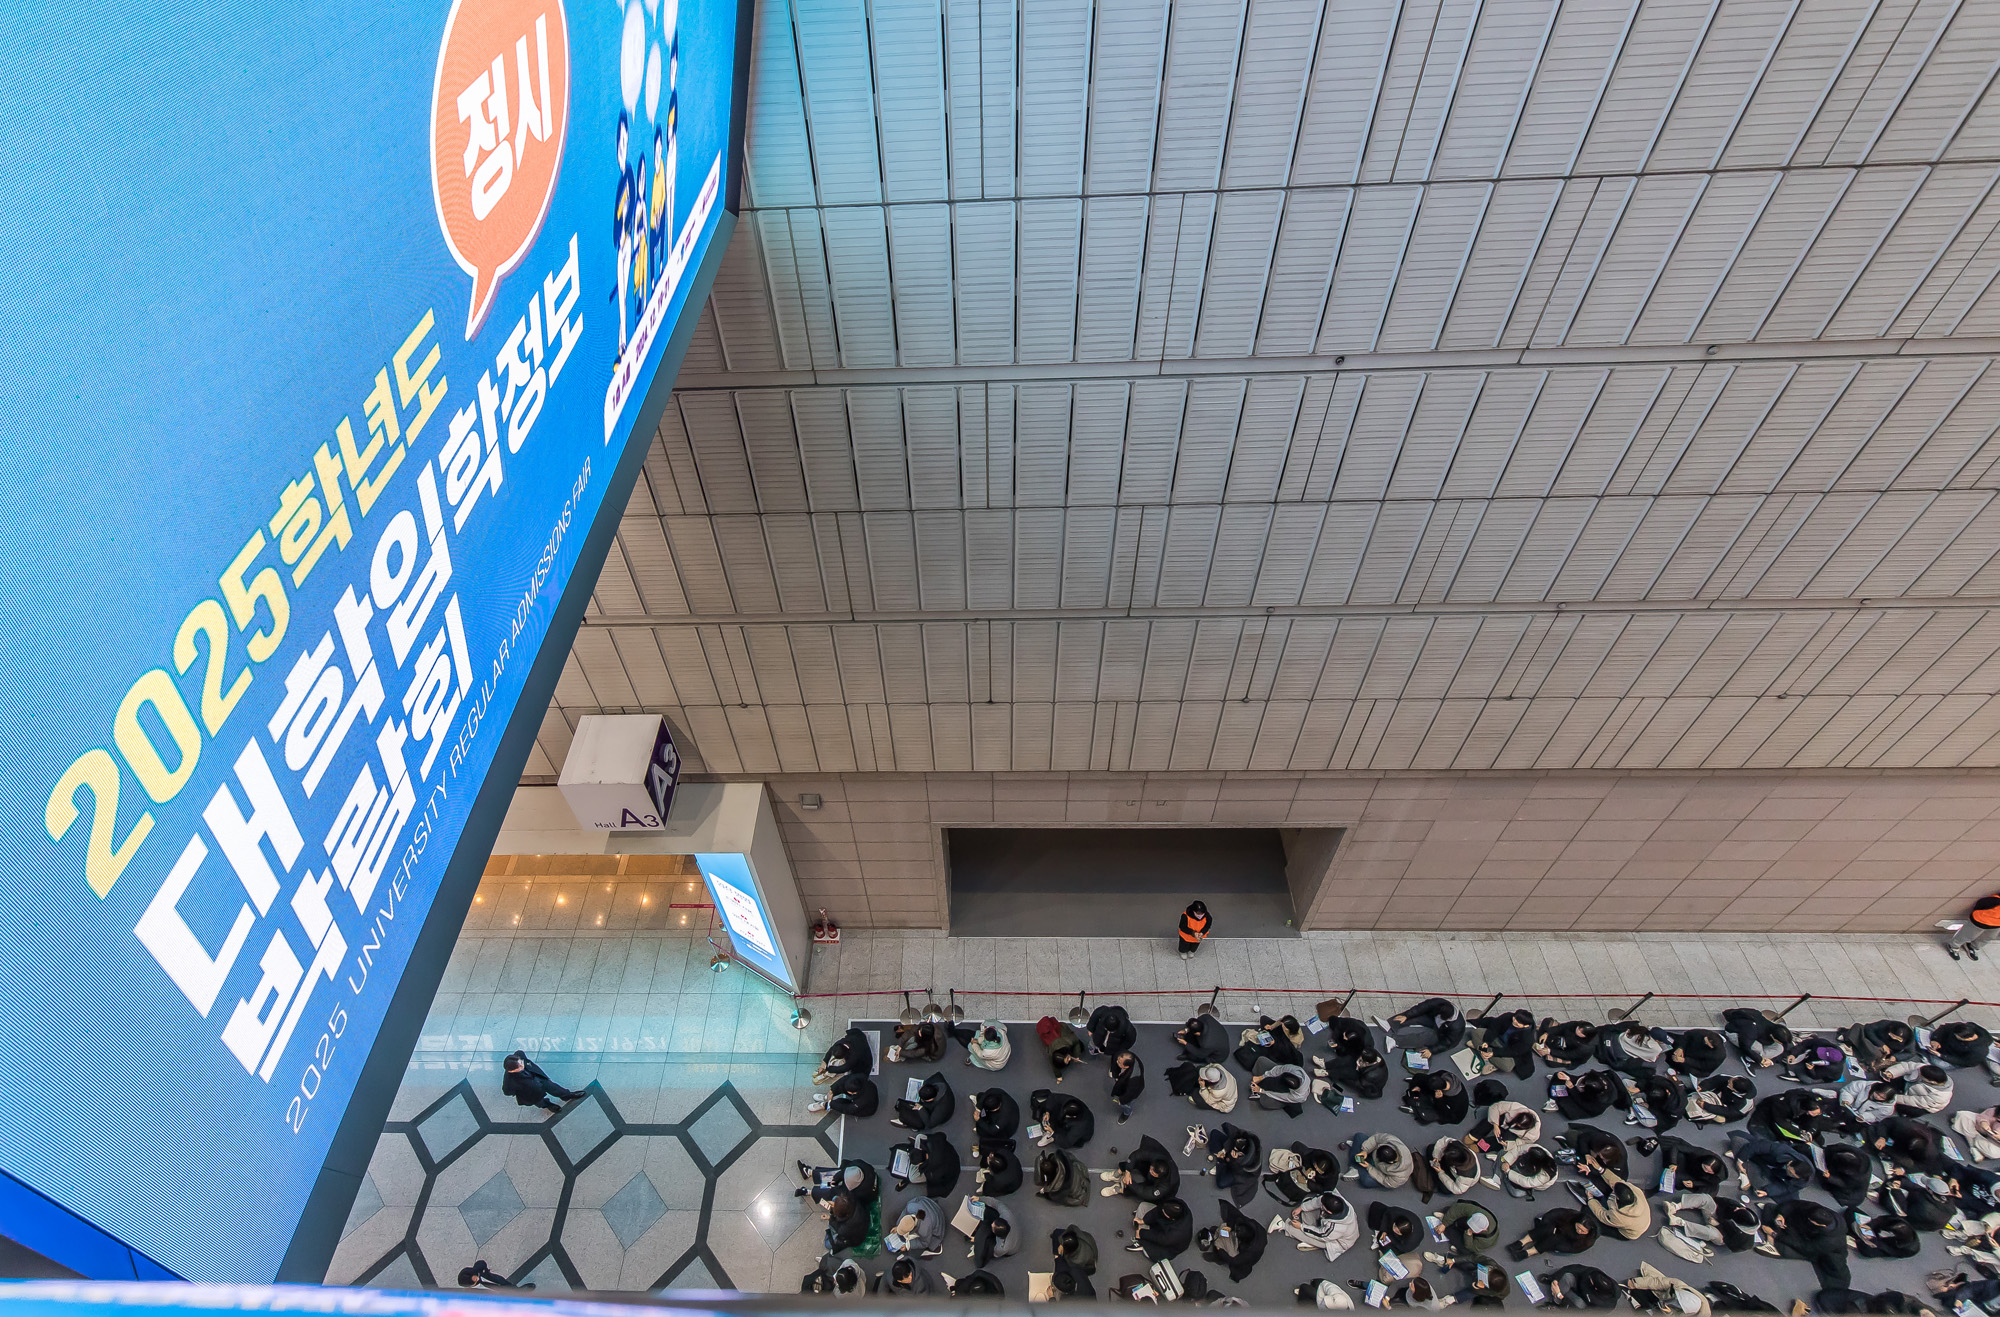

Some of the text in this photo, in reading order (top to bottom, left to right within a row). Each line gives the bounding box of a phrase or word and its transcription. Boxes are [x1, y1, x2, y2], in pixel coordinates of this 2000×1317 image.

[457, 12, 553, 221] 정시
[45, 307, 449, 900] 2025학년도
[134, 232, 584, 1018] 대학입학정보
[221, 593, 474, 1085] 박람회
[285, 455, 593, 1135] 2025 UNIVERSITY REGULAR ADMISSIONS FAIR
[620, 808, 660, 828] A3
[651, 743, 677, 818] A3
